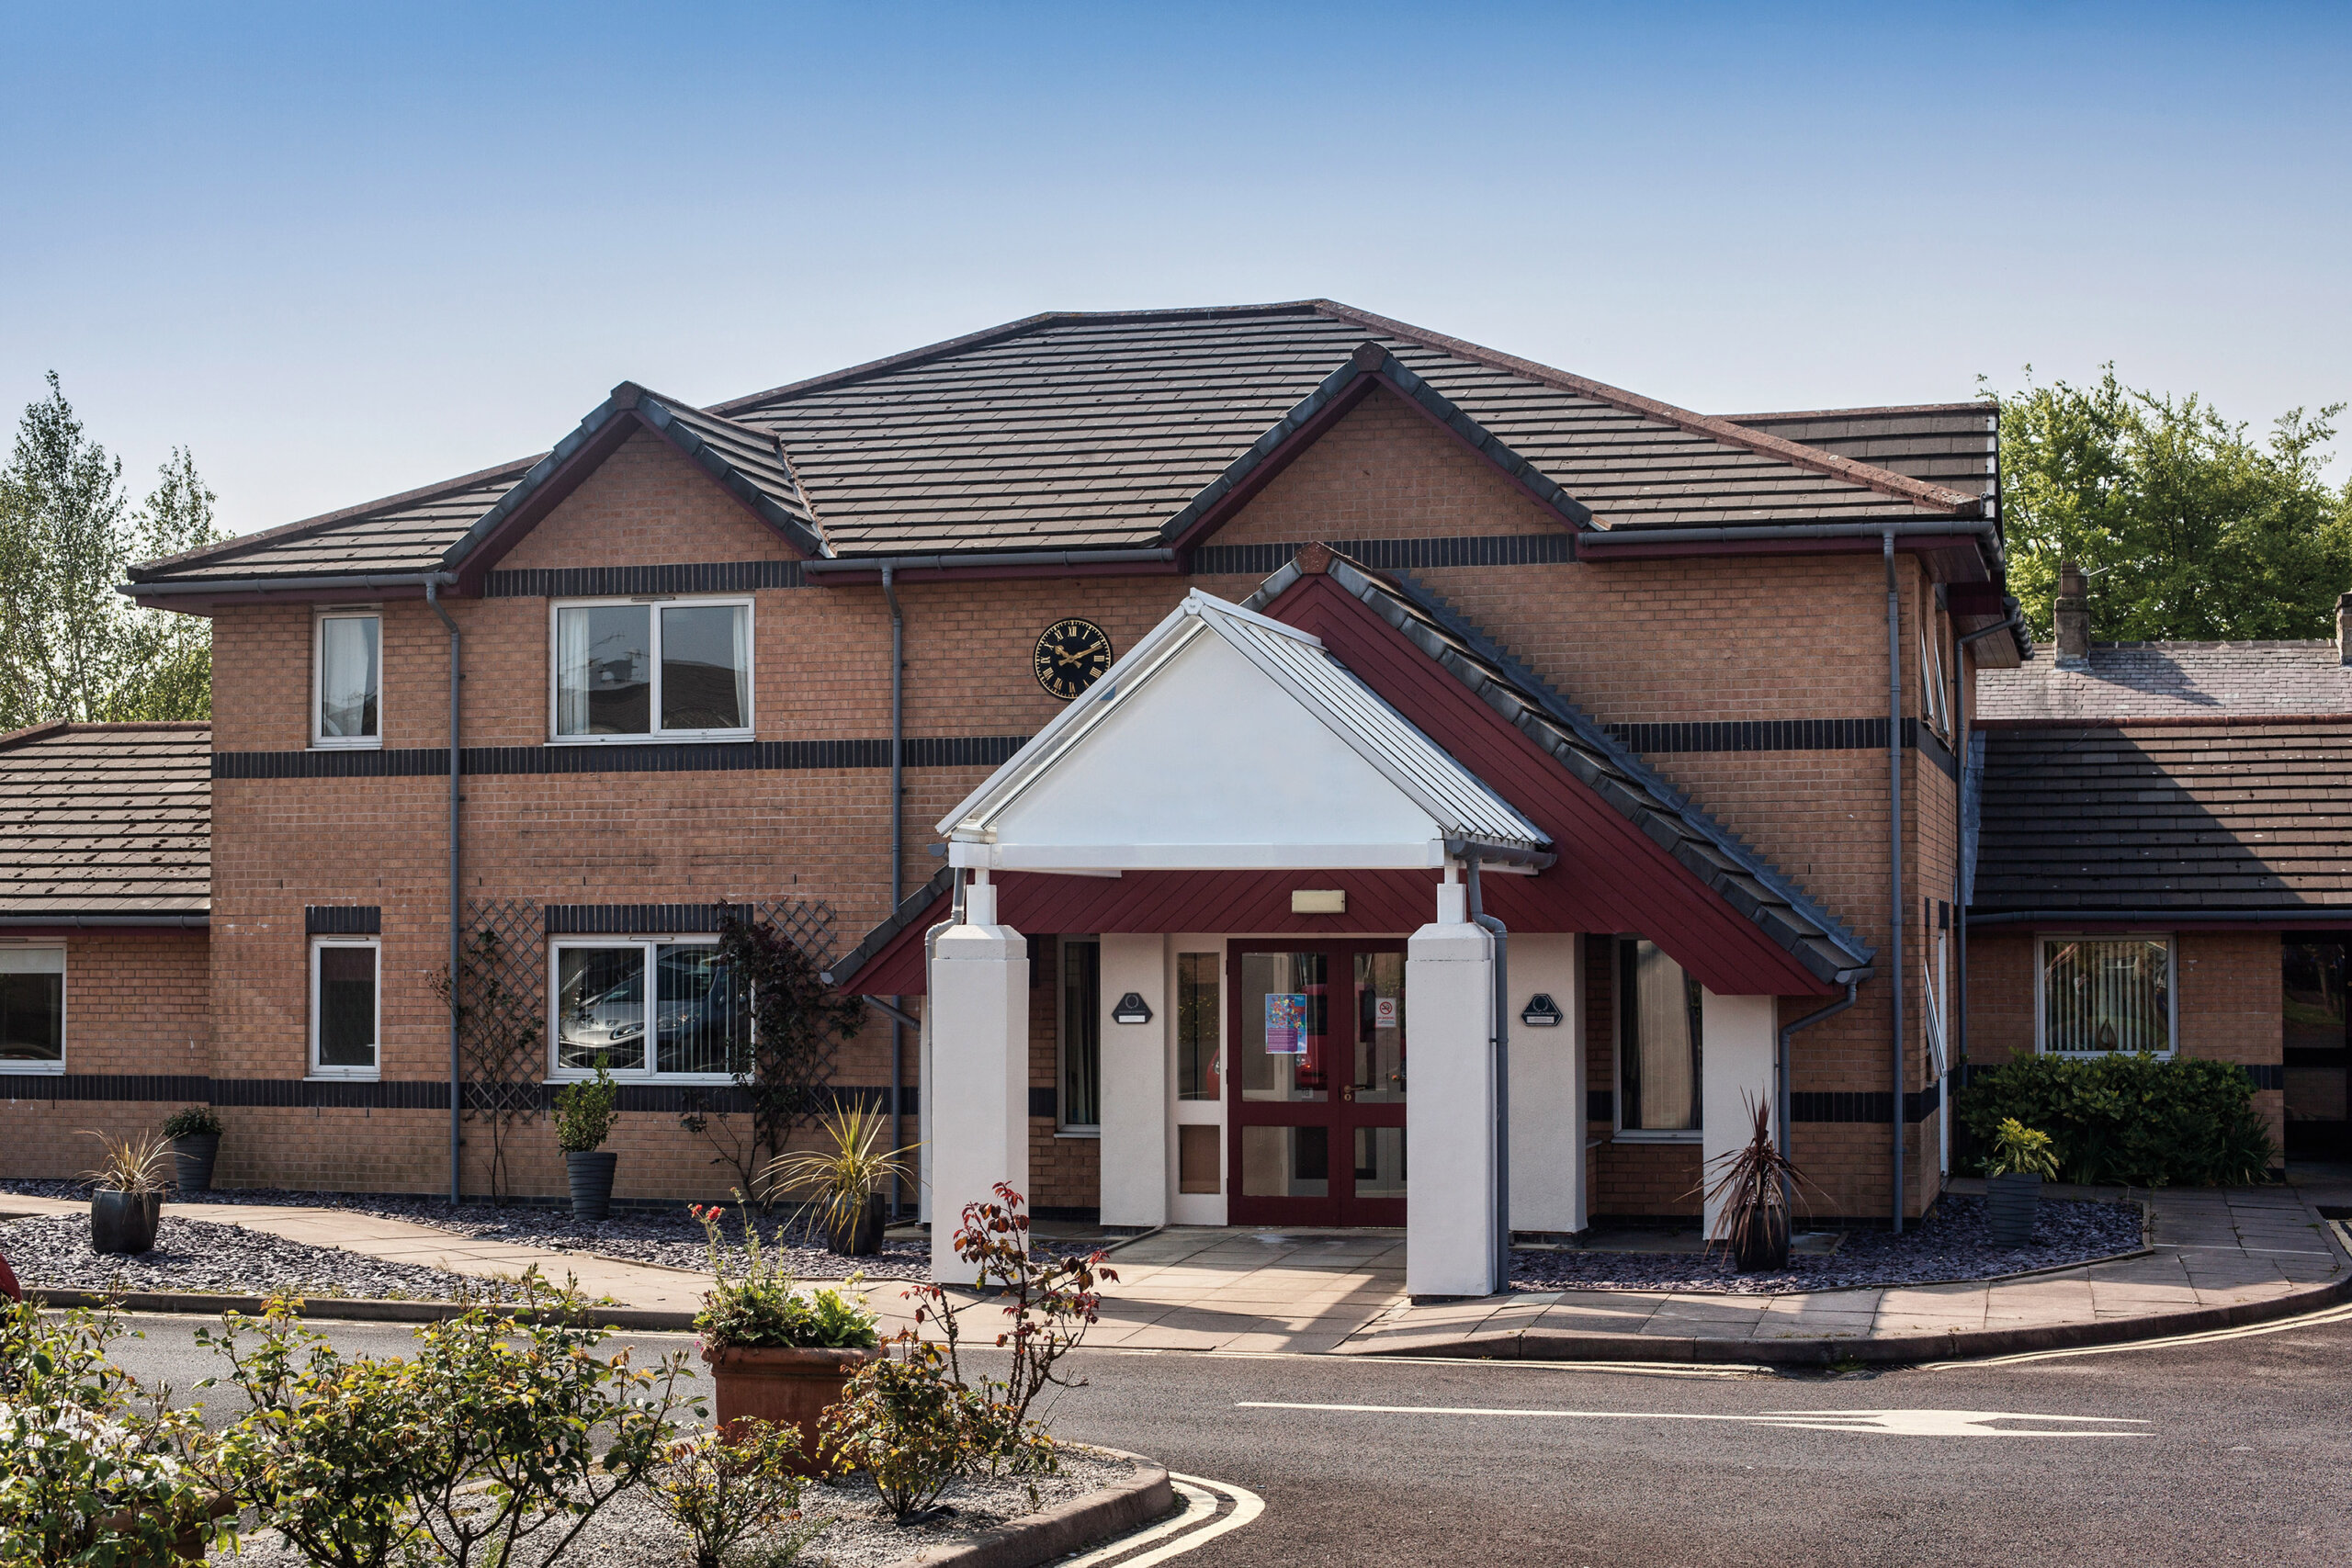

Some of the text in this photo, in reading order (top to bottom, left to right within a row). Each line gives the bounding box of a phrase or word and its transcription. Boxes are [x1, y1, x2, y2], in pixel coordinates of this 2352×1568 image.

[1055, 629, 1064, 641] XI
[1068, 626, 1077, 637] XII
[1081, 630, 1090, 639] I
[1044, 641, 1054, 650] X
[1043, 667, 1055, 681] VIII
[1090, 667, 1102, 678] IIII
[1054, 678, 1063, 691] VII
[1069, 682, 1076, 693] VI
